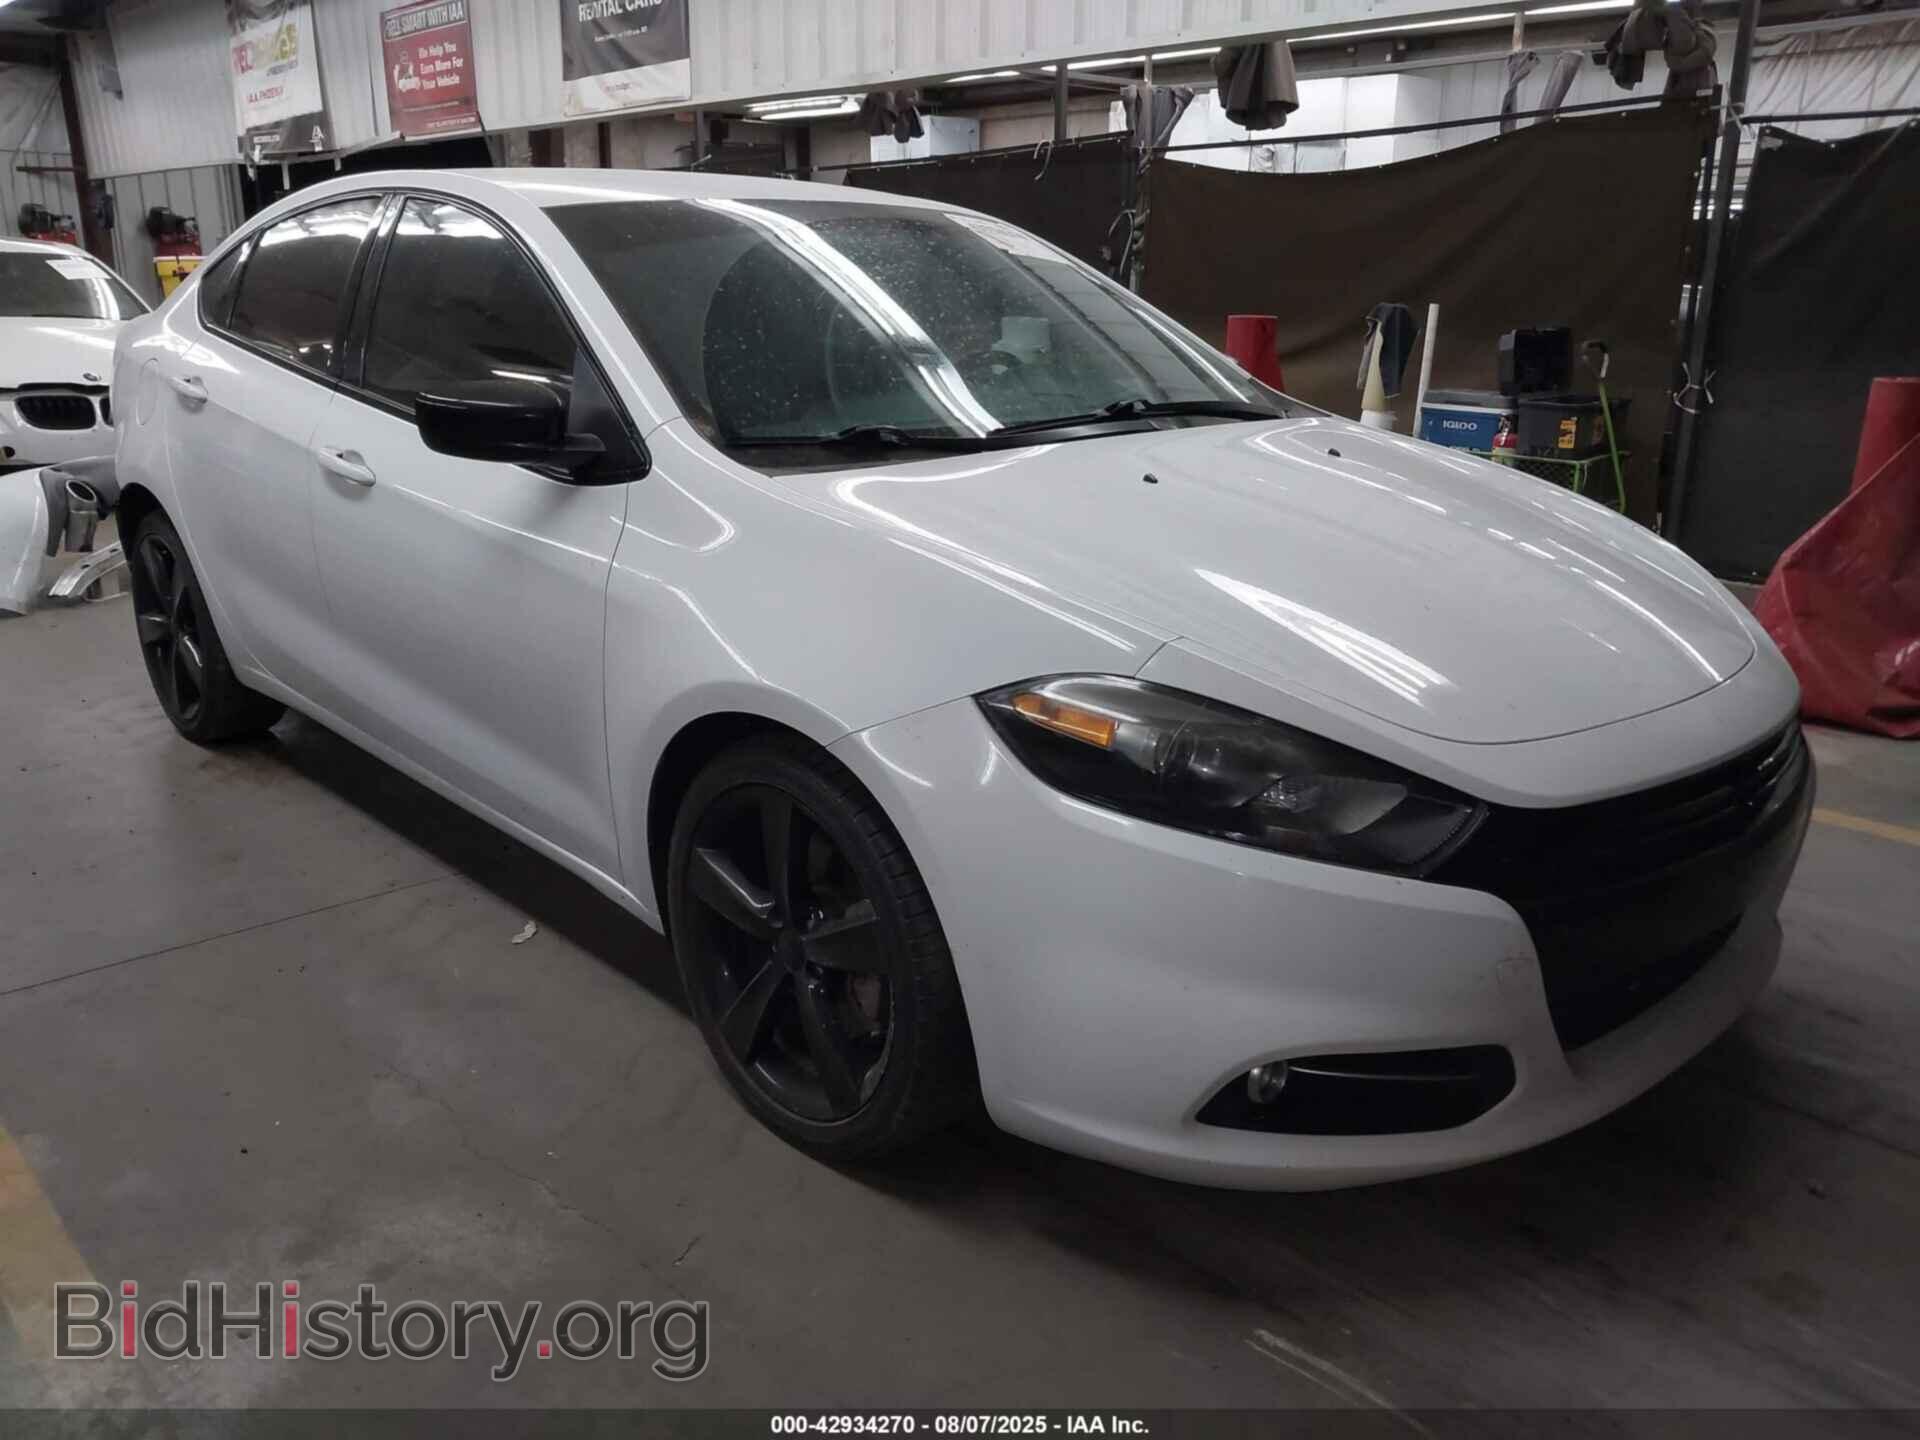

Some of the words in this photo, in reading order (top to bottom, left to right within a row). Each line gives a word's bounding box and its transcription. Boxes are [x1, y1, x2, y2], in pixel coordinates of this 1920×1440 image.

[426, 5, 448, 26] WITH
[448, 1, 464, 21] IAA
[579, 0, 623, 21] RENTAL
[429, 44, 444, 57] Help
[443, 41, 457, 53] You
[435, 59, 452, 72] More
[452, 56, 464, 68] For
[421, 79, 436, 90] Your
[436, 73, 460, 88] Vehicle
